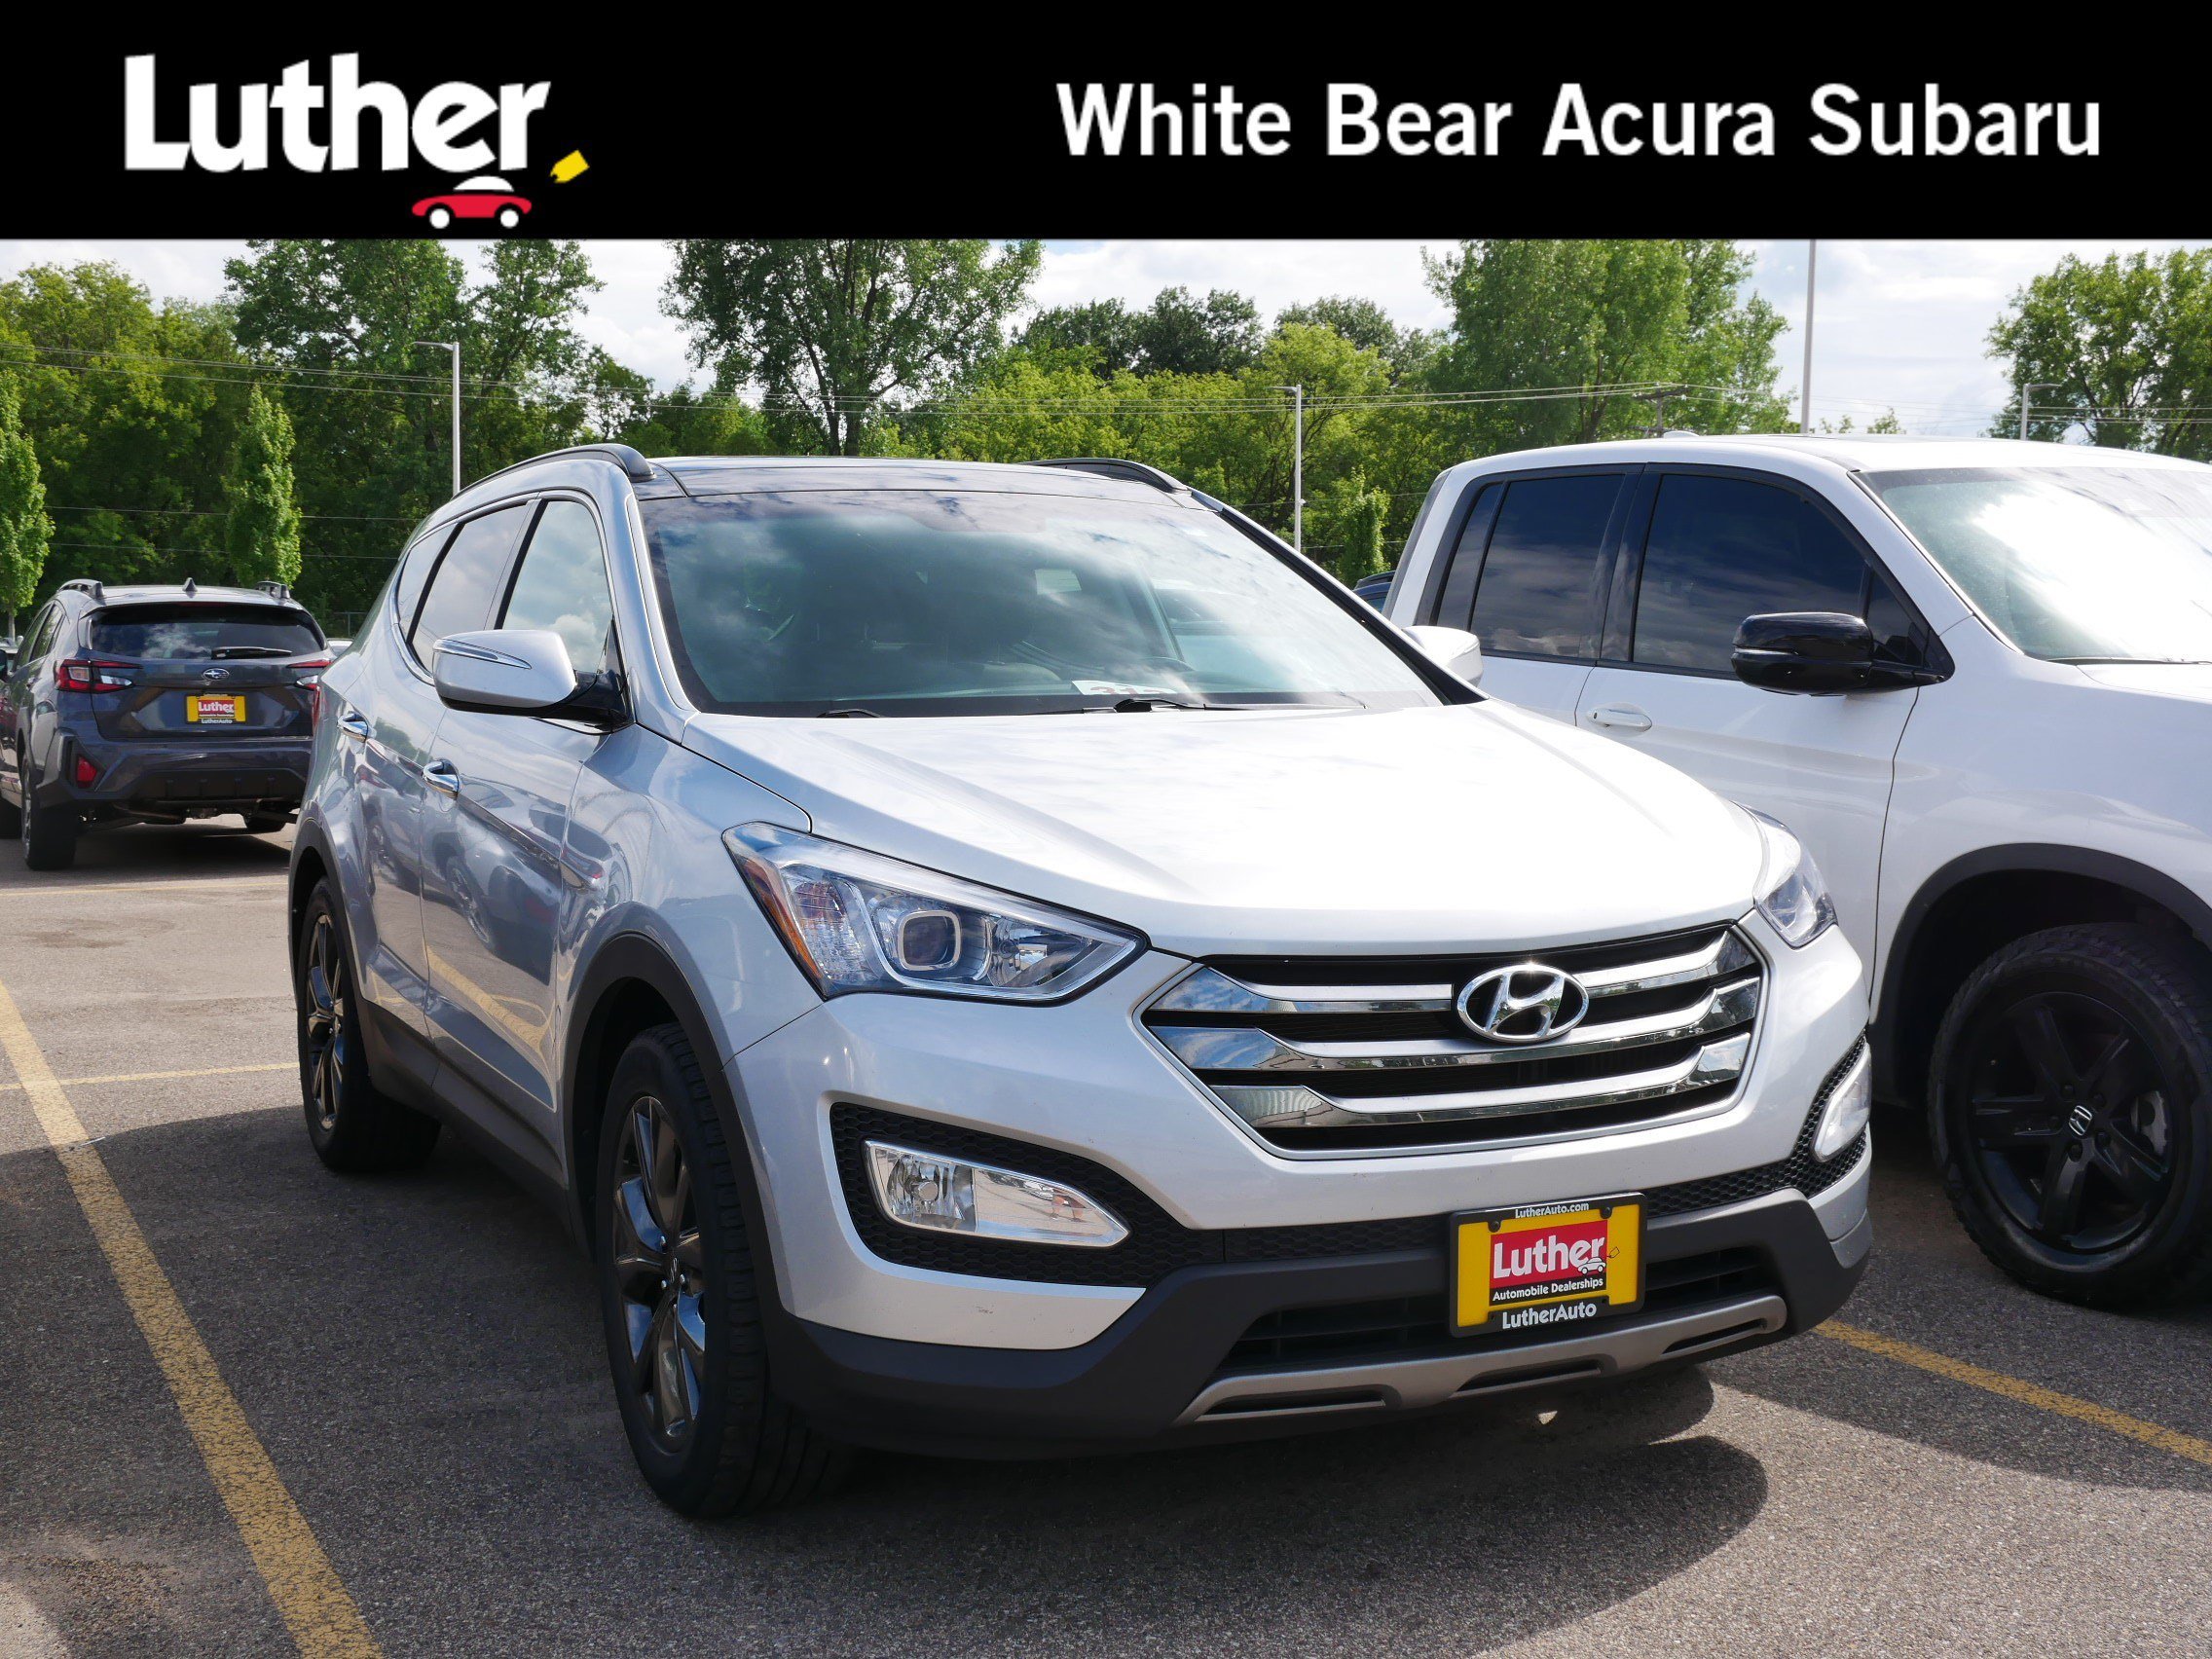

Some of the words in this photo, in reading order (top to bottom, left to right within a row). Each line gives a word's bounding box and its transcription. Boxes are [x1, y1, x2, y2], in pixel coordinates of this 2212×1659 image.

[198, 701, 235, 712] Luther
[1514, 1202, 1590, 1219] LutherAuto.com
[1493, 1235, 1605, 1279] Luther
[1492, 1283, 1549, 1302] Automobile
[1551, 1276, 1604, 1293] Dealerships
[1501, 1301, 1598, 1330] LutherAuto
